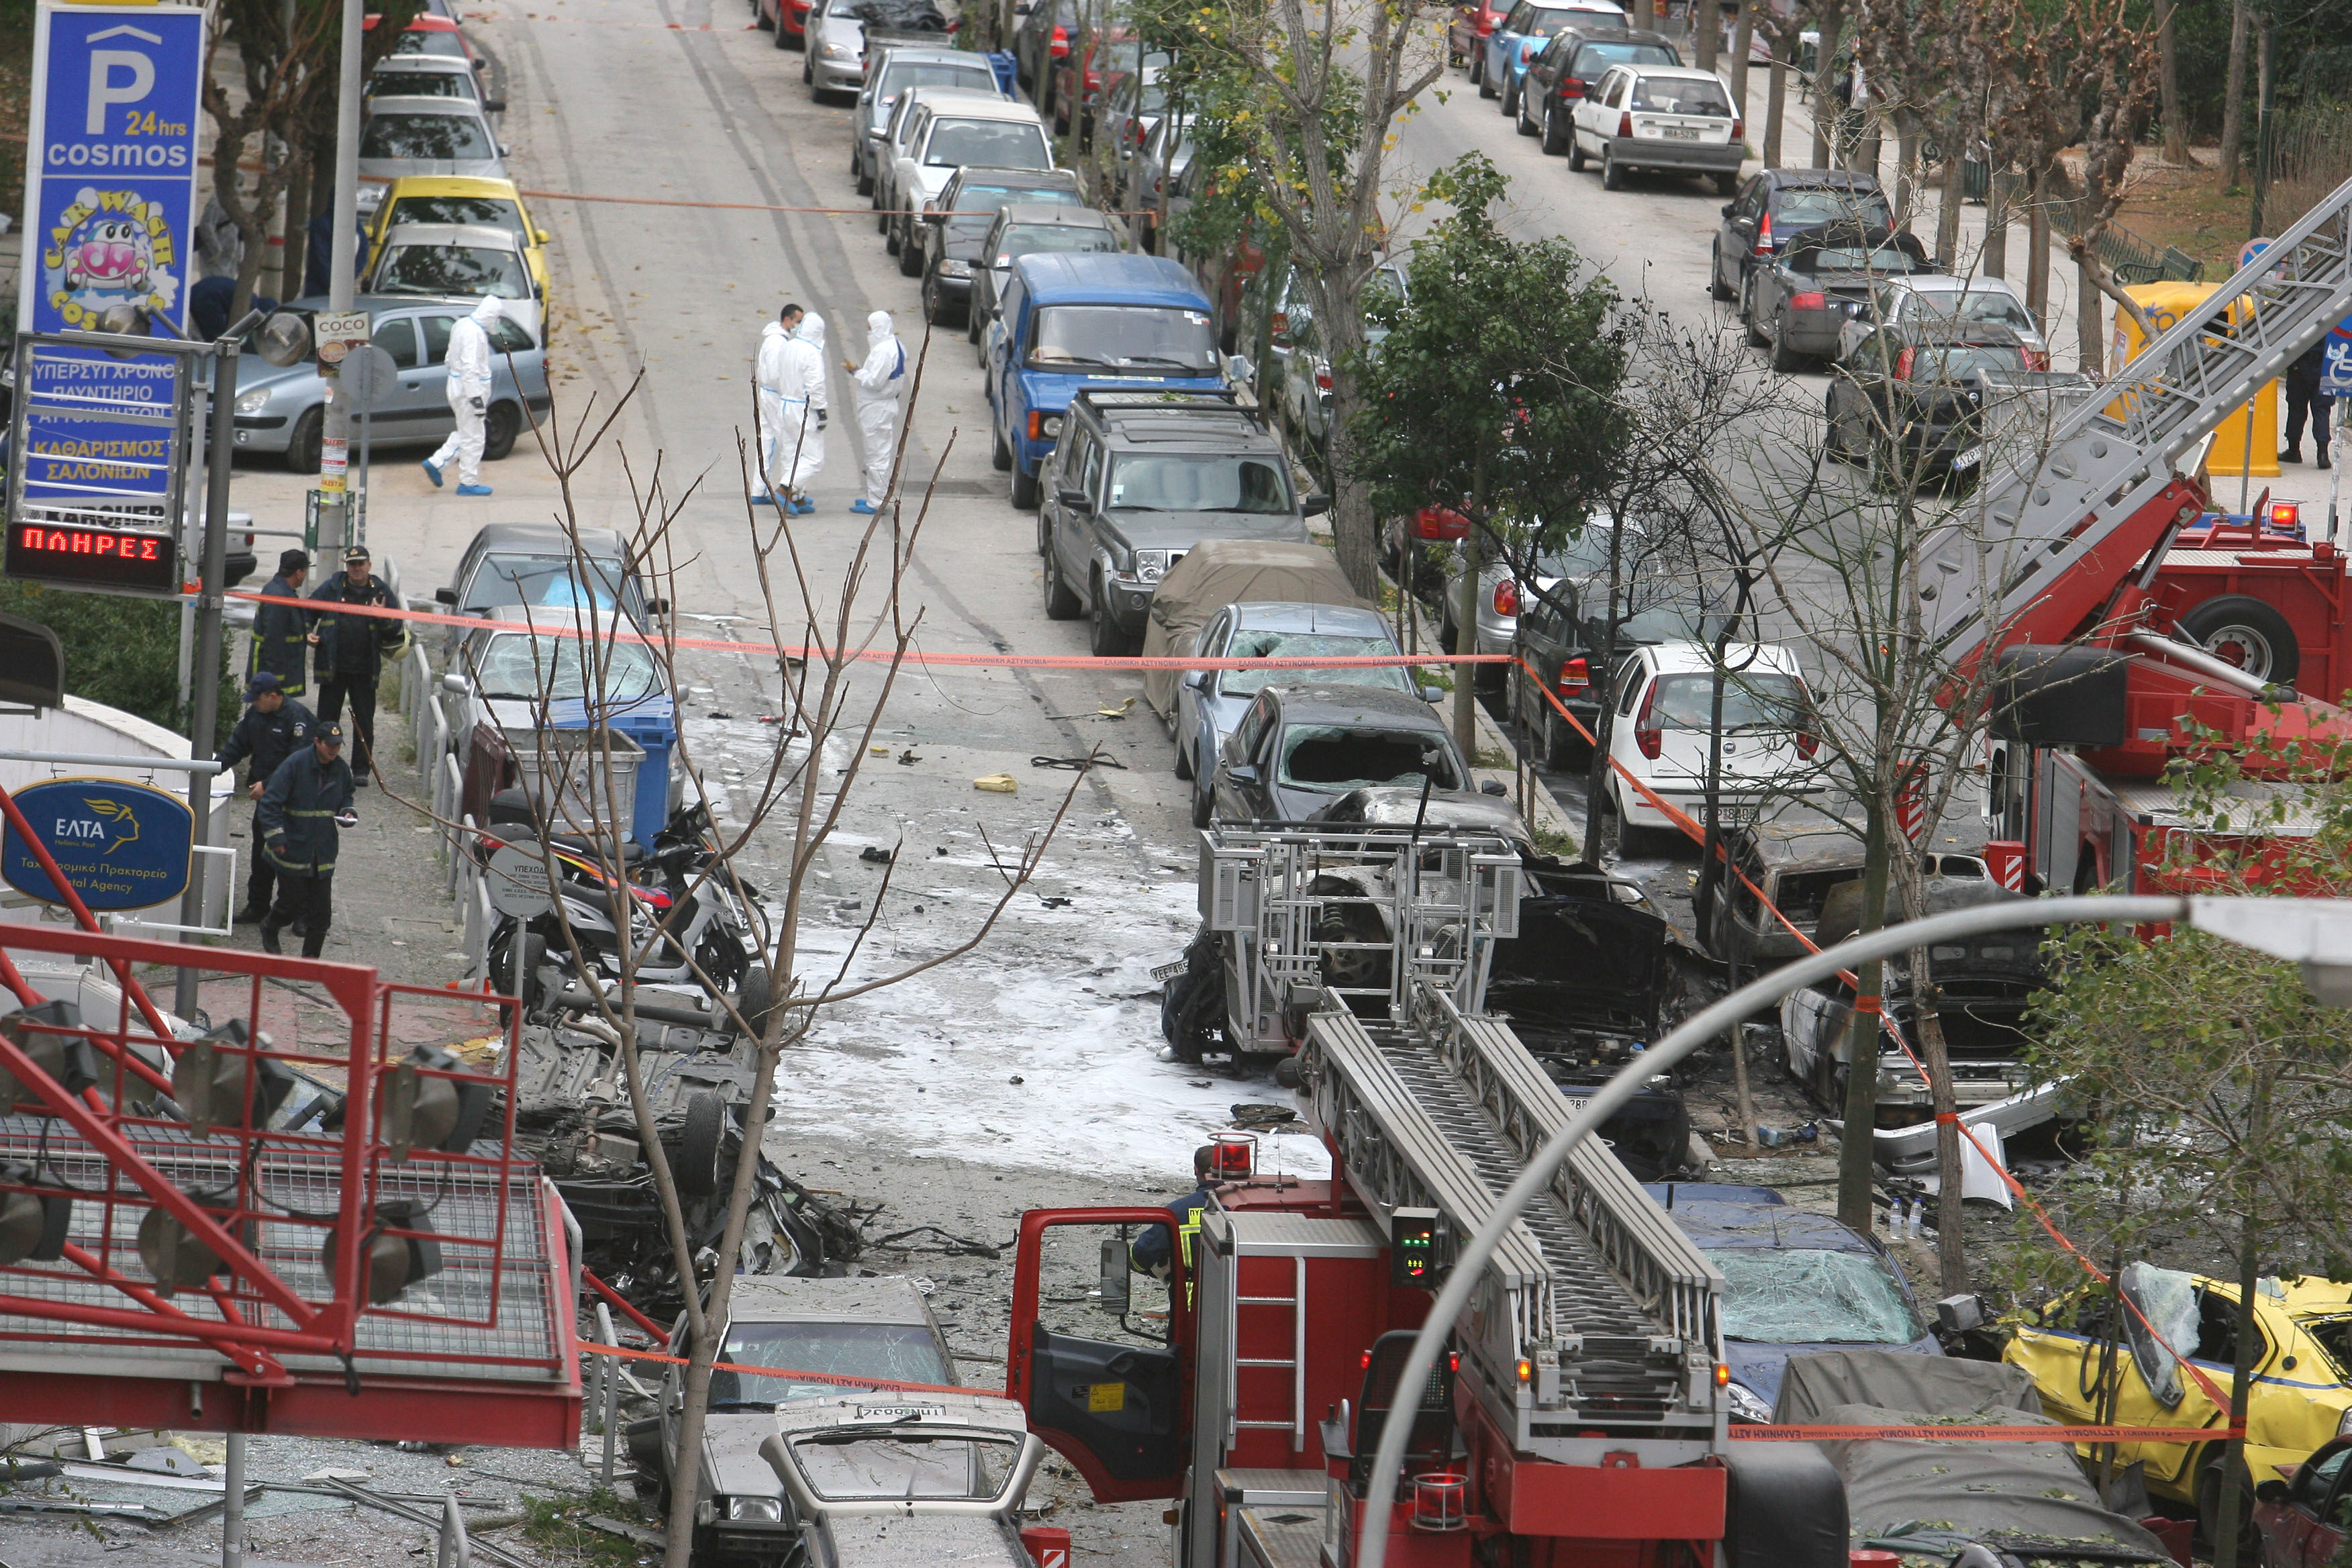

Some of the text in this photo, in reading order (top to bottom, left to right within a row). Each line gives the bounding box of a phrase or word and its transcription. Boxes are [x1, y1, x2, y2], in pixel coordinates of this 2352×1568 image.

[87, 50, 155, 135] P
[126, 111, 187, 136] 24 hrs
[48, 143, 187, 167] cosmos
[52, 291, 165, 332] COSS
[319, 320, 364, 332] COCO
[52, 385, 153, 401] ΠΛΥΝΤΗΡΙΟ
[34, 440, 164, 457] ΚΑΘΑΡΙΣΜΟΣ
[46, 463, 150, 481] ΣΑΛΟΝΙΩΝ
[23, 528, 159, 560] ΠΛΗΡΕΣ
[56, 818, 105, 839] ΕΛΤΑ
[21, 857, 167, 879] Ταχρομικό Πρακτορείο
[90, 879, 133, 895] Agency
[799, 1374, 852, 1387] ΑΣΤΥΝΟΜΙΑ
[854, 1380, 900, 1392] ΕΛΛΗΝΙΚΗ
[1754, 1429, 1801, 1439] ΕΛΛΗΝΙΚΗ
[1879, 1430, 1934, 1438] ΑΣΤΥΝΟΜΙΑ
[1937, 1430, 1986, 1438] ΕΛΛΗΝΙΚΗ
